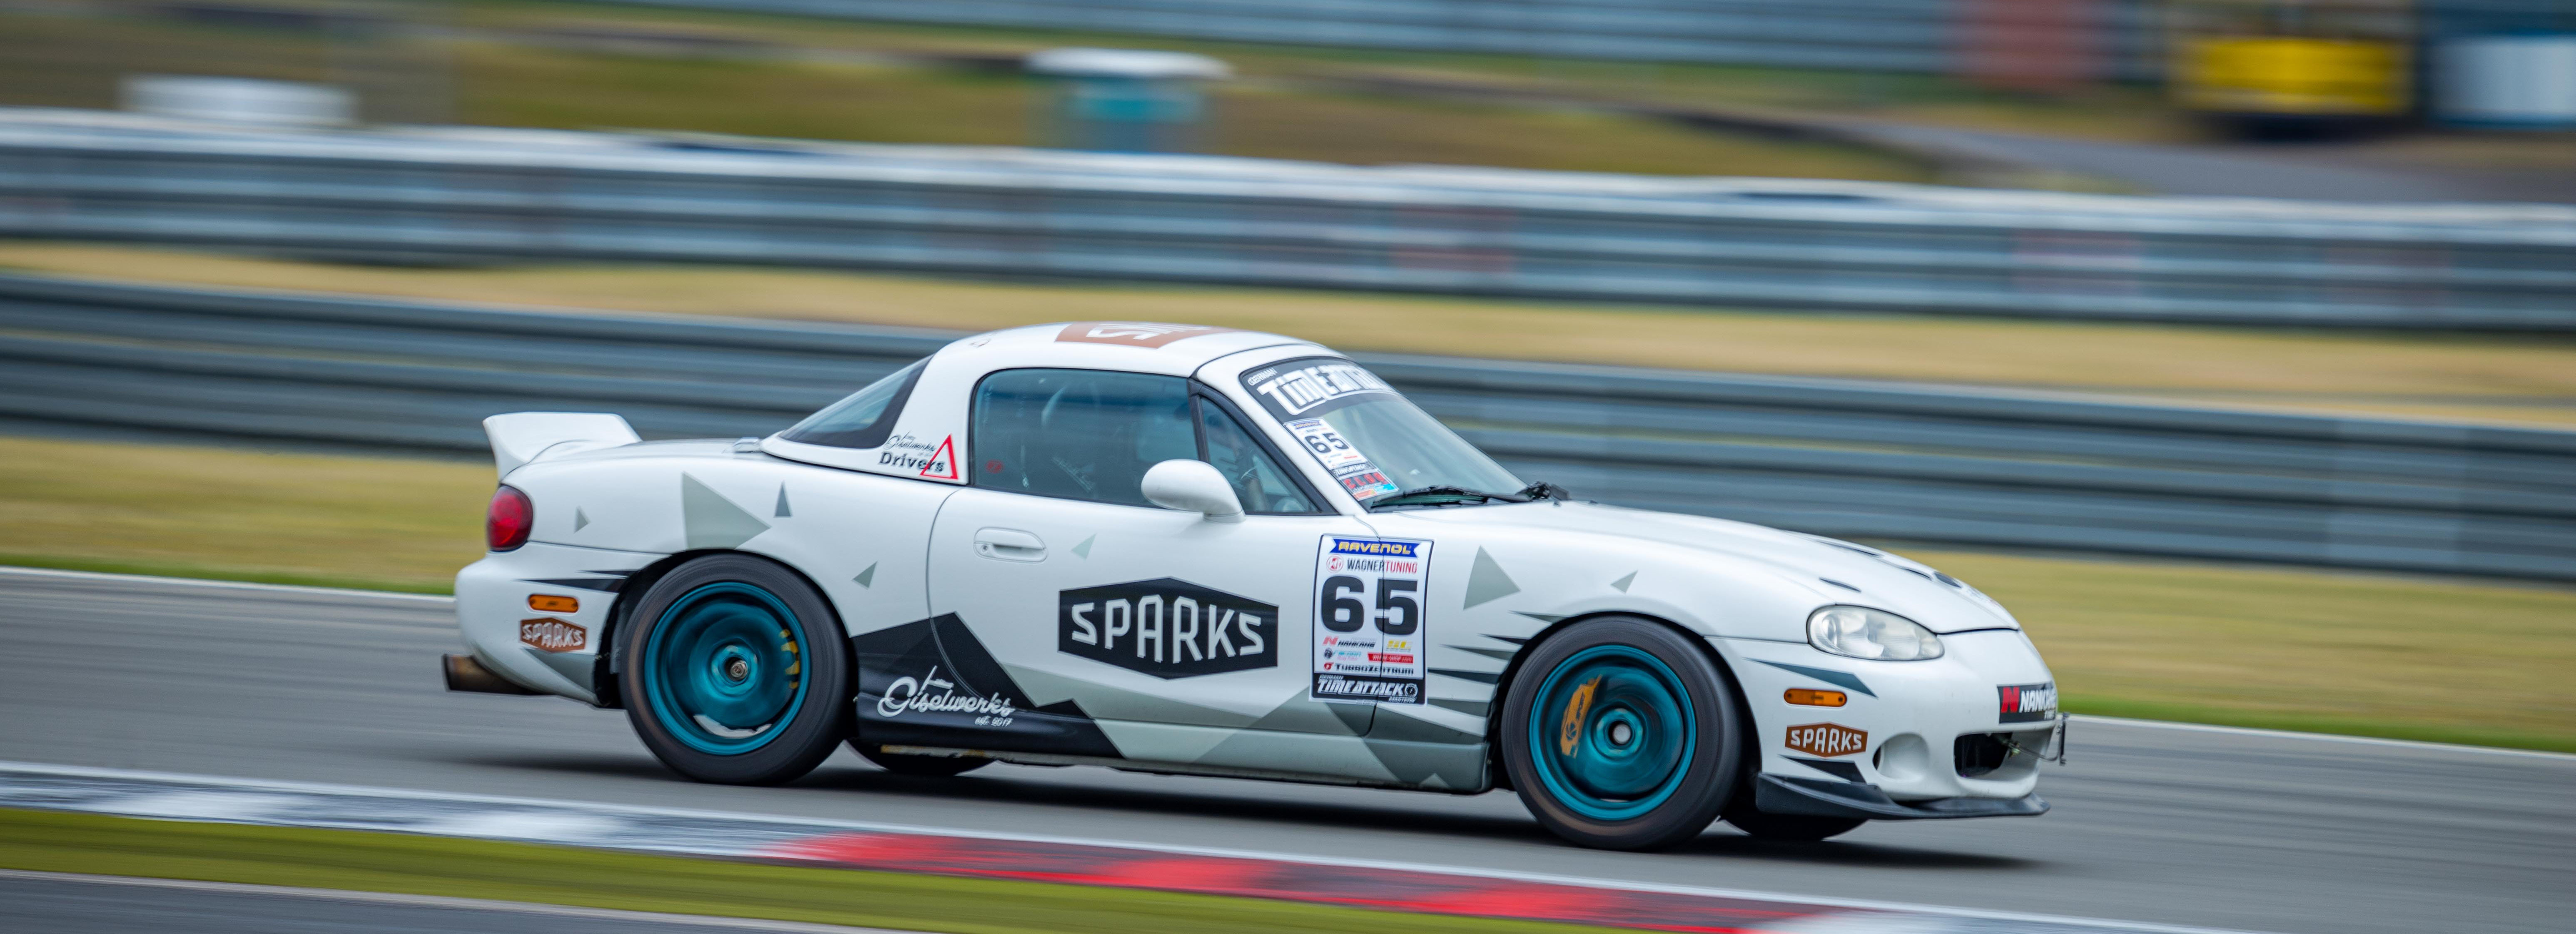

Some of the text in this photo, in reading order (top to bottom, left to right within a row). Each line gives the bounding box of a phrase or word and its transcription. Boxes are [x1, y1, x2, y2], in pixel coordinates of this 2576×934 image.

[1305, 432, 1349, 453] 65
[878, 451, 945, 472] Drivers
[1338, 541, 1411, 554] RAVENOL
[1320, 576, 1418, 636] 65
[523, 622, 583, 648] SPARKS
[1072, 594, 1264, 664] SPARKS
[1353, 680, 1404, 697] ATTACK
[992, 718, 1013, 727] 2017
[1791, 728, 1862, 753] SPARKS
